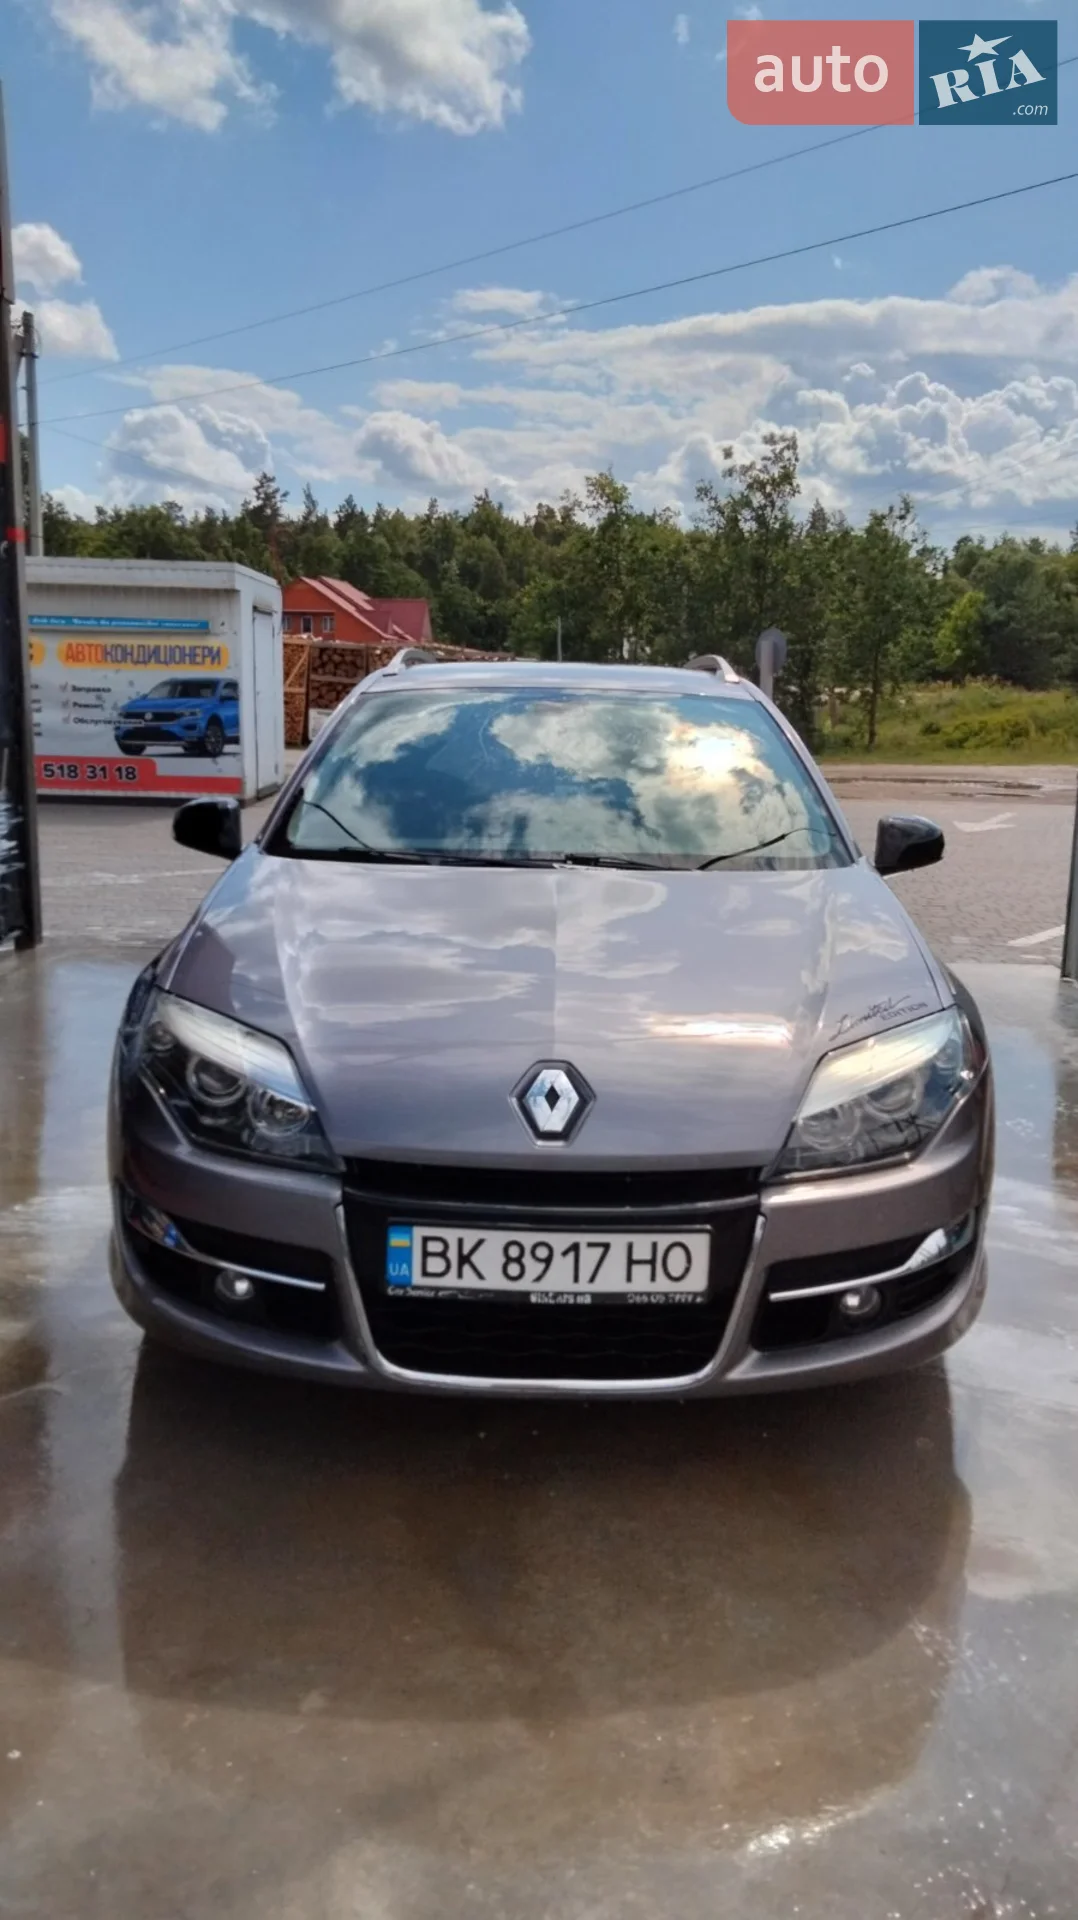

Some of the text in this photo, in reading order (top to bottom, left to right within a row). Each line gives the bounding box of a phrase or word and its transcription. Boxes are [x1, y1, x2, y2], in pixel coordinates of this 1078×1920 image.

[65, 642, 222, 667] АВТОКОНДИЦІОНЕРИ
[43, 763, 137, 781] 518 31 18
[880, 1001, 929, 1021] EDITION
[421, 1235, 692, 1284] BK 8917 HO
[388, 1262, 410, 1278] UA
